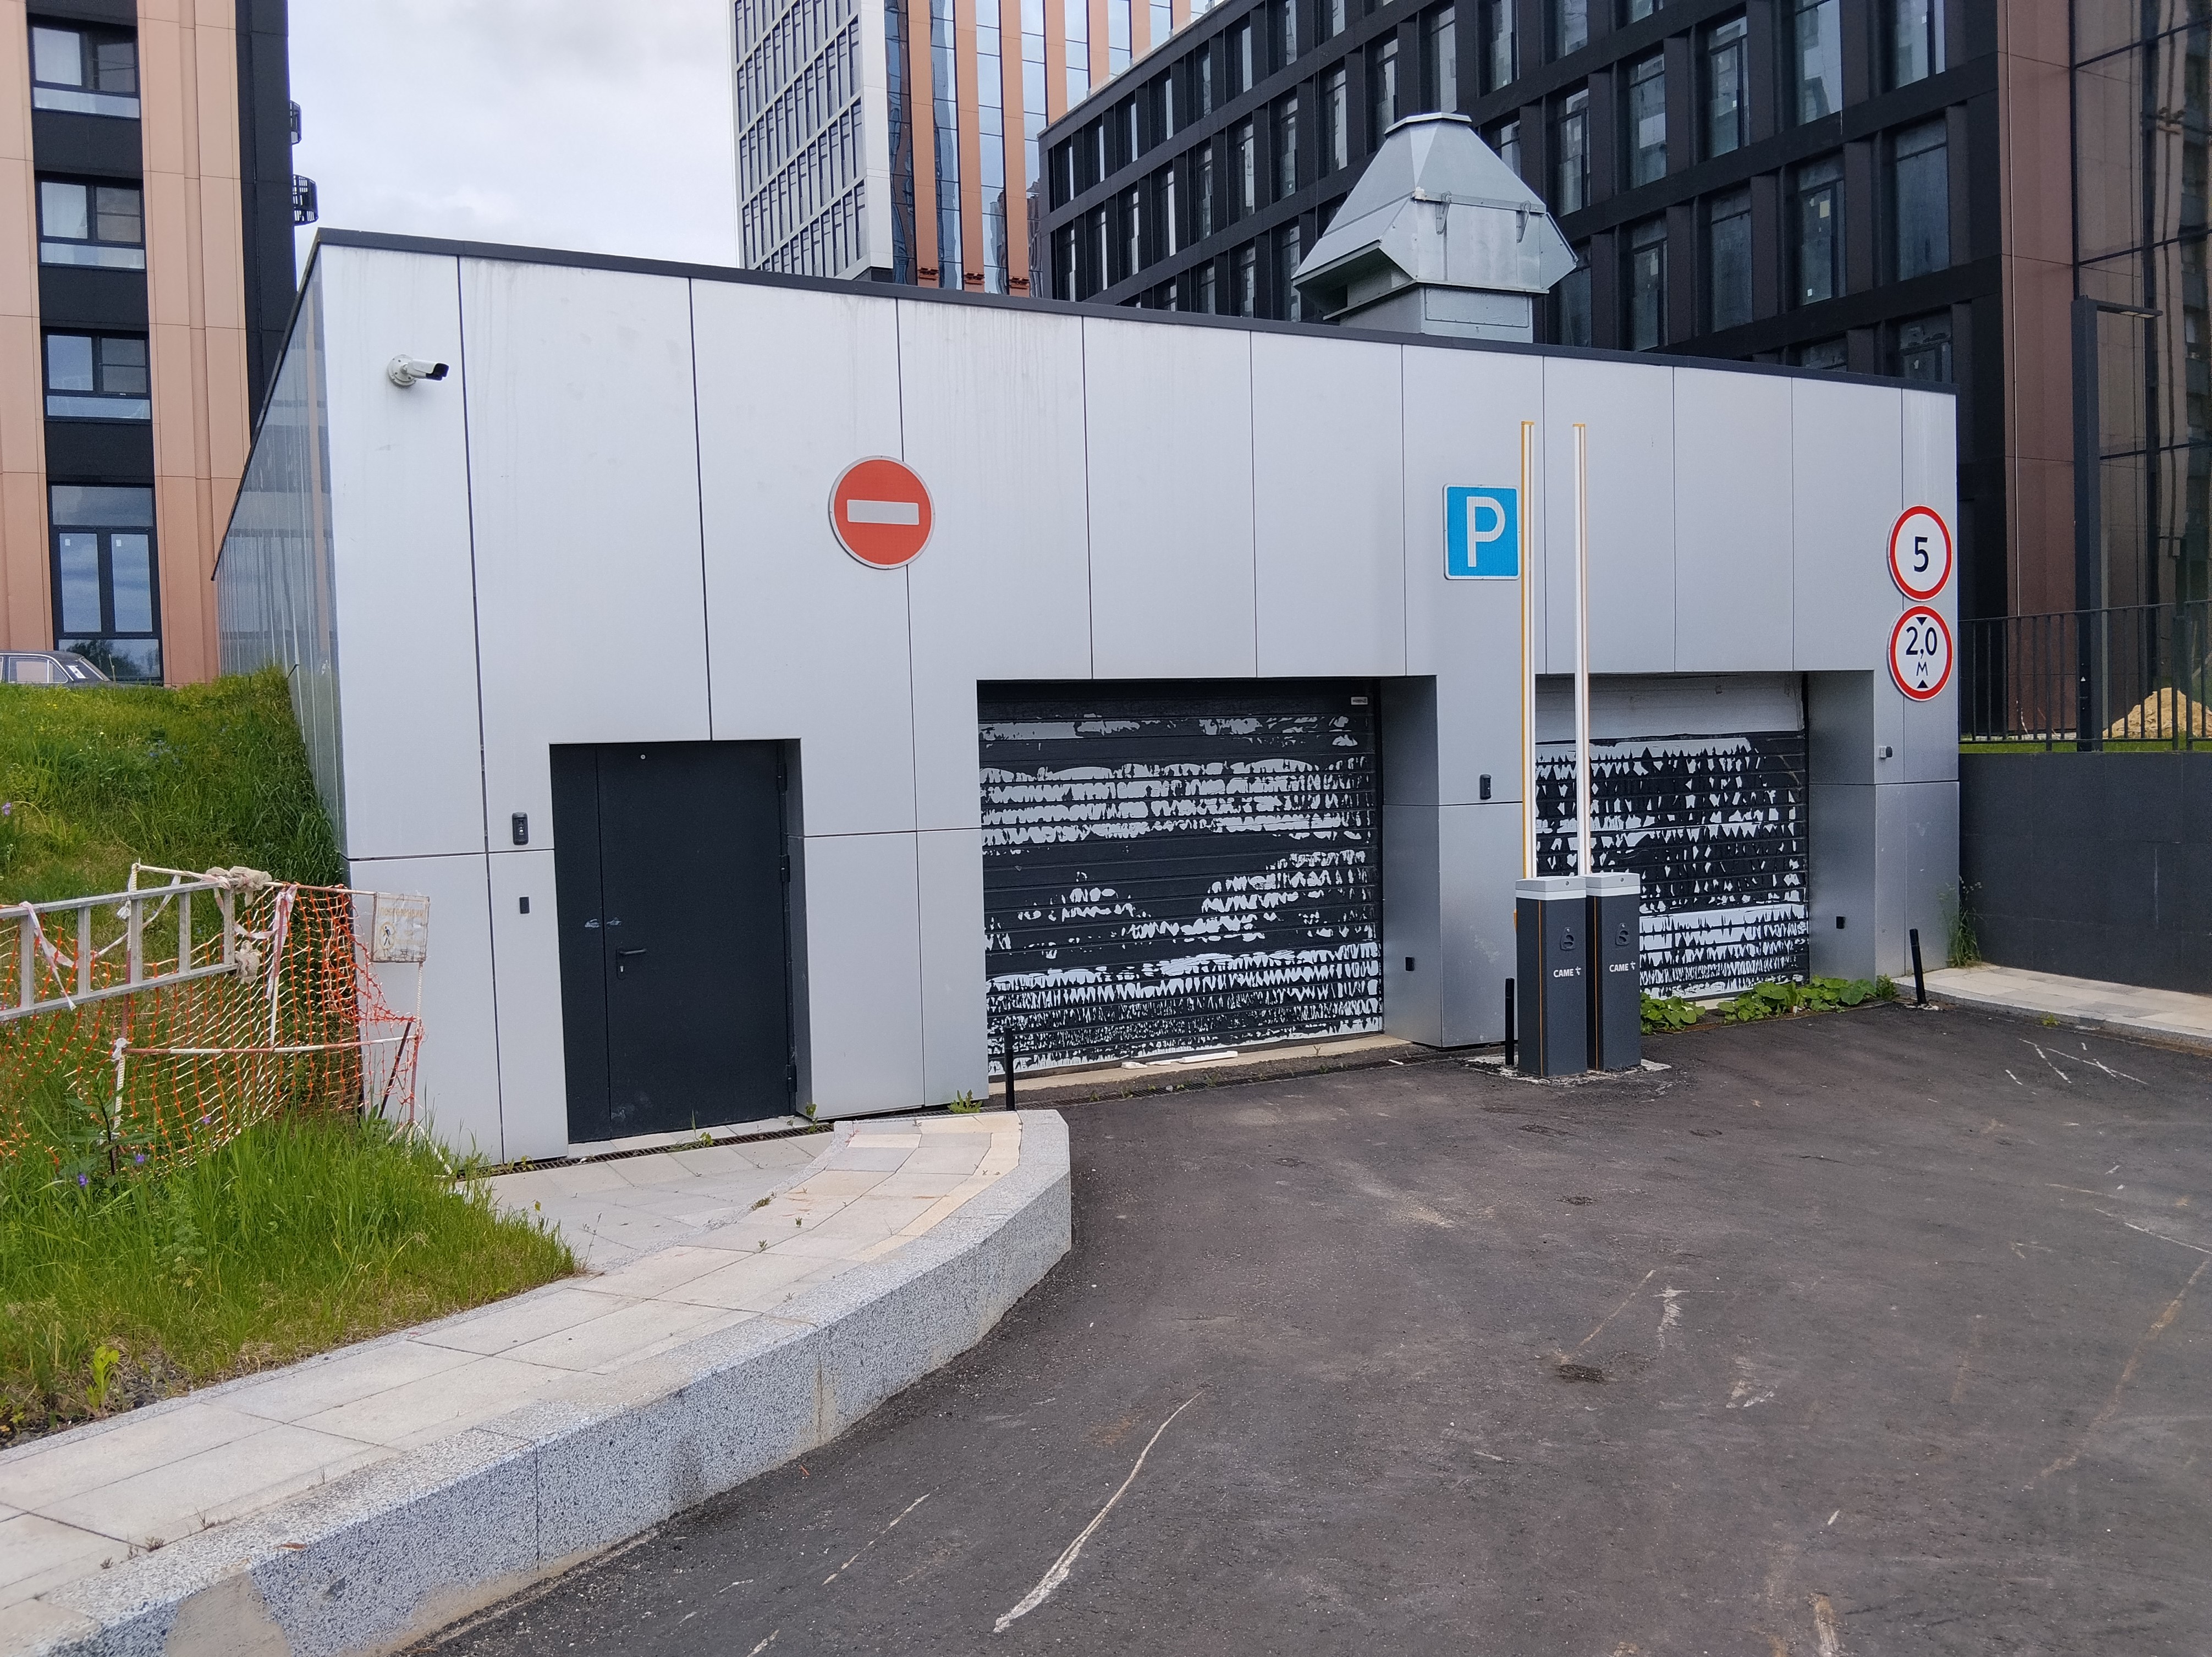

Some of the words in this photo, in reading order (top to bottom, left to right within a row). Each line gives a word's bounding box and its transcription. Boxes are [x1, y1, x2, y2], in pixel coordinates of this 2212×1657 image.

[1467, 496, 1505, 567] P
[1913, 536, 1929, 572] 5
[1906, 626, 1938, 659] 2,0
[1553, 968, 1574, 978] CAME
[1609, 963, 1629, 972] CAME
